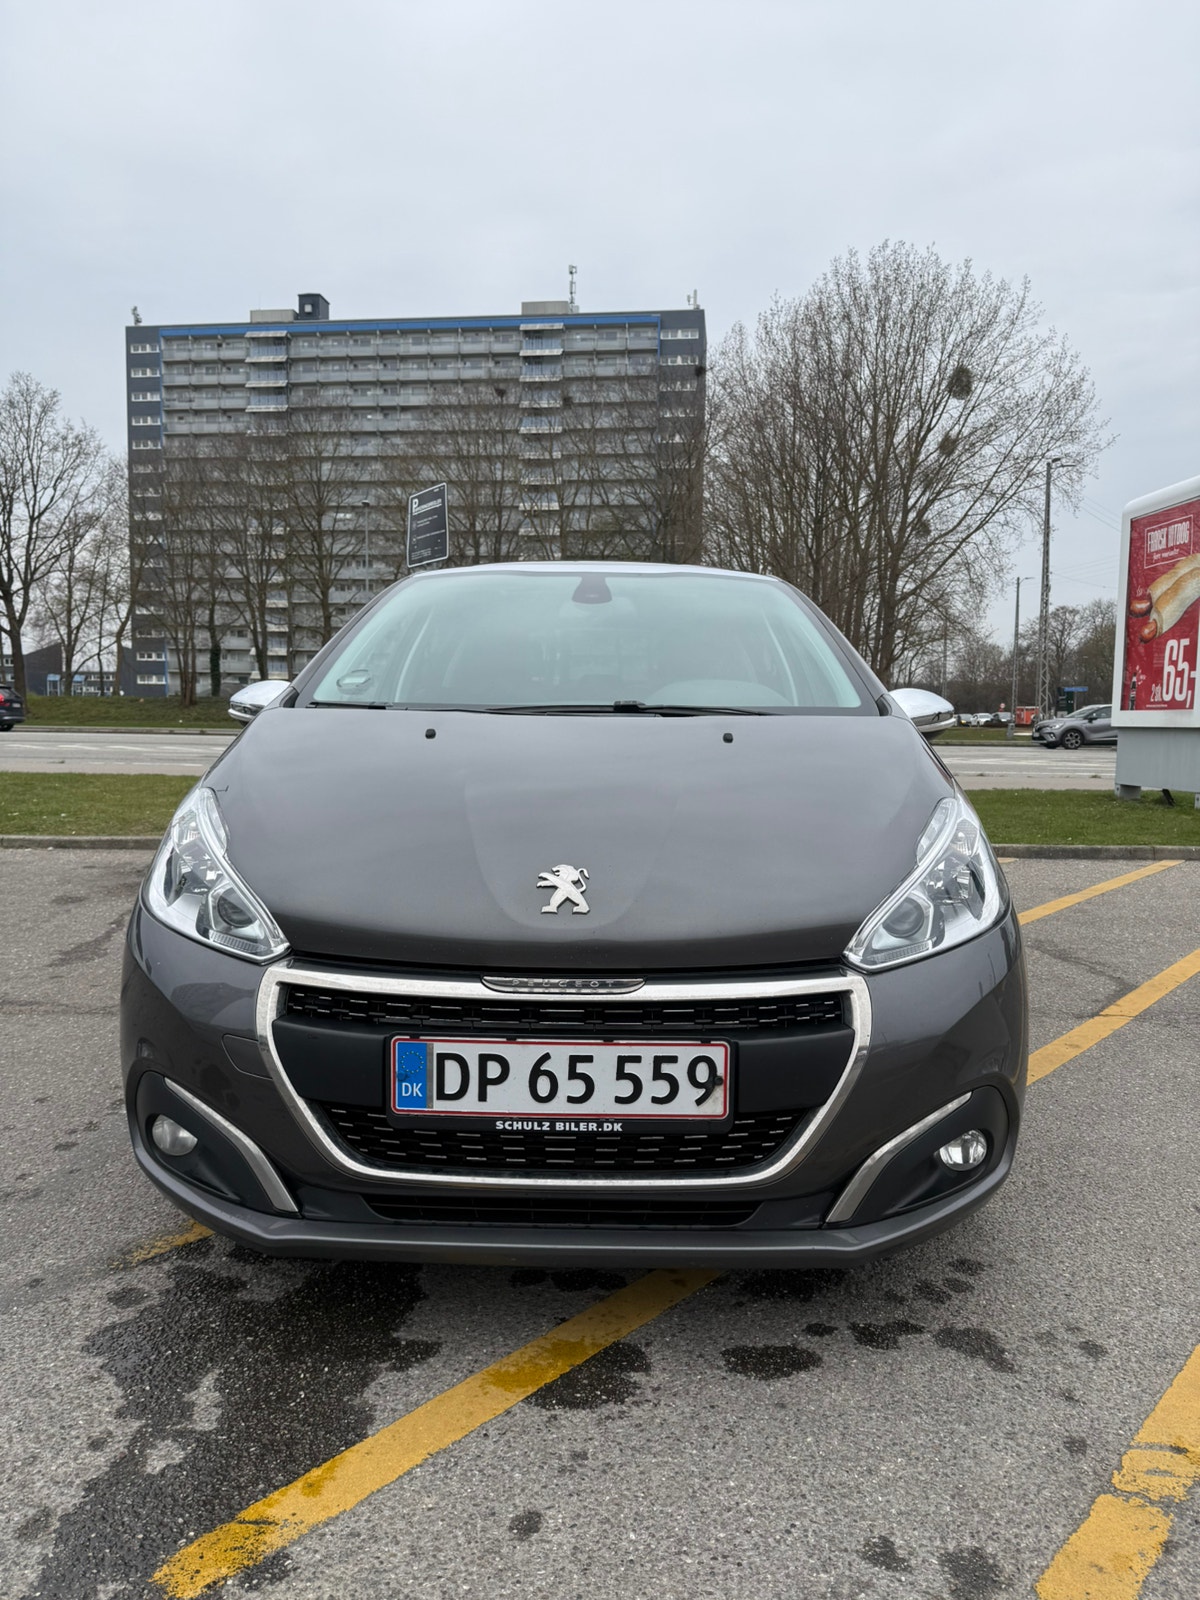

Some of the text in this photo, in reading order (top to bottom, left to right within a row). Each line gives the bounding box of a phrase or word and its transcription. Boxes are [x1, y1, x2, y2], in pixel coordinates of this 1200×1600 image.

[435, 1051, 719, 1107] DP 65 559
[401, 1082, 423, 1098] DK
[495, 1120, 623, 1132] SCHULZ BILER.DK
